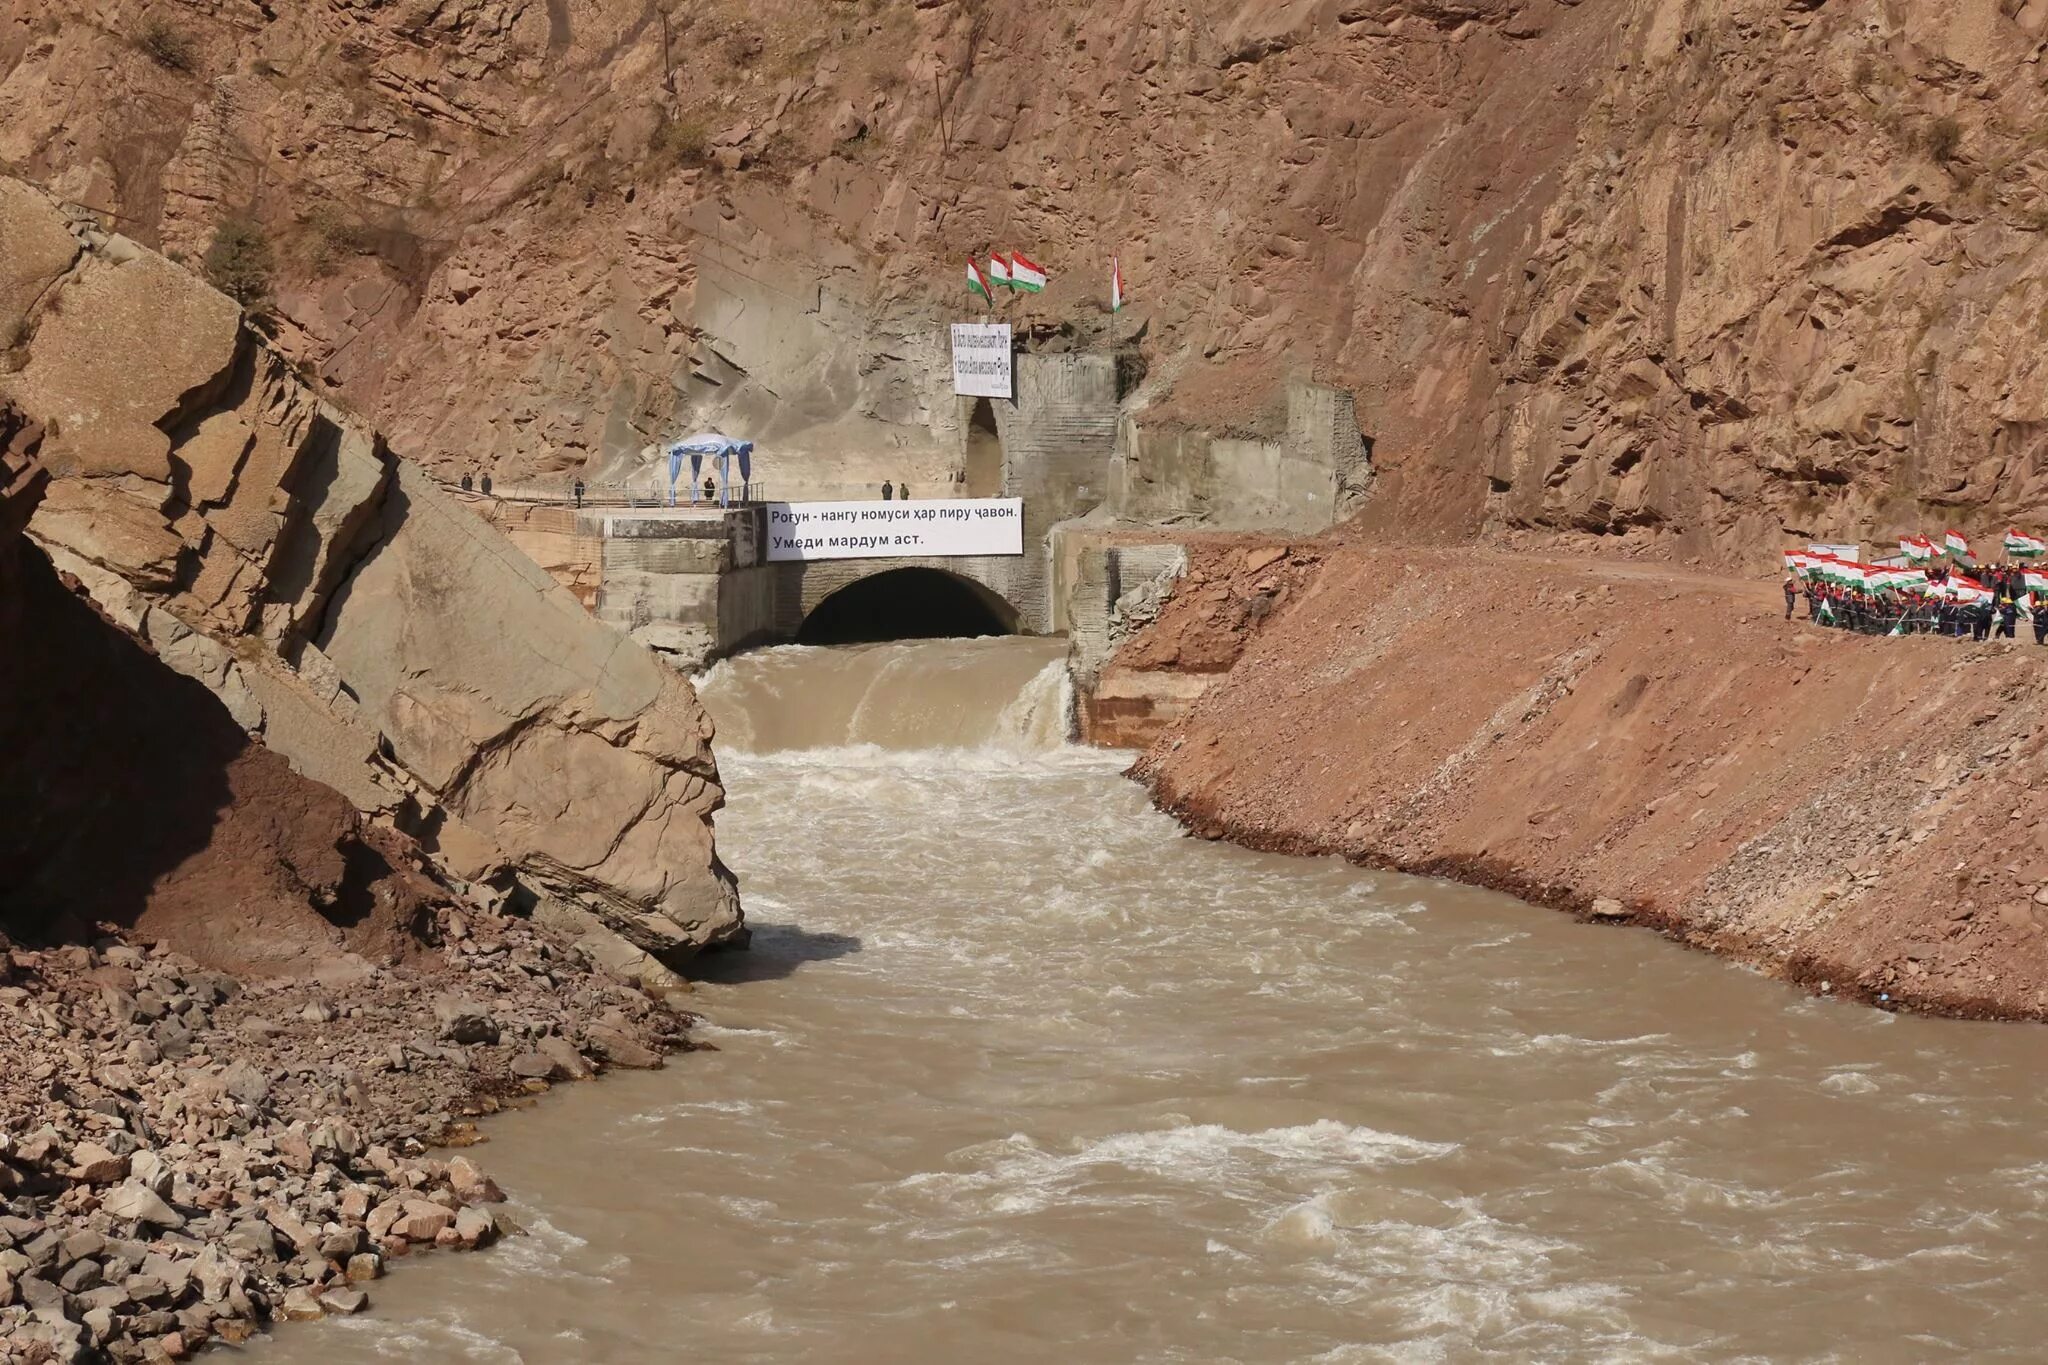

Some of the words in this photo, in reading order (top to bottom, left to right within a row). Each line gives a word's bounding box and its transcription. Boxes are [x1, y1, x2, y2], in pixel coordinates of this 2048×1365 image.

[772, 511, 809, 526] Роғун
[821, 511, 858, 523] нангу
[861, 509, 910, 522] номуси
[913, 509, 936, 521] ҳар
[940, 508, 971, 521] пиру
[773, 536, 823, 549] Умеди
[829, 535, 889, 549] мардум
[894, 535, 924, 545] аст.
